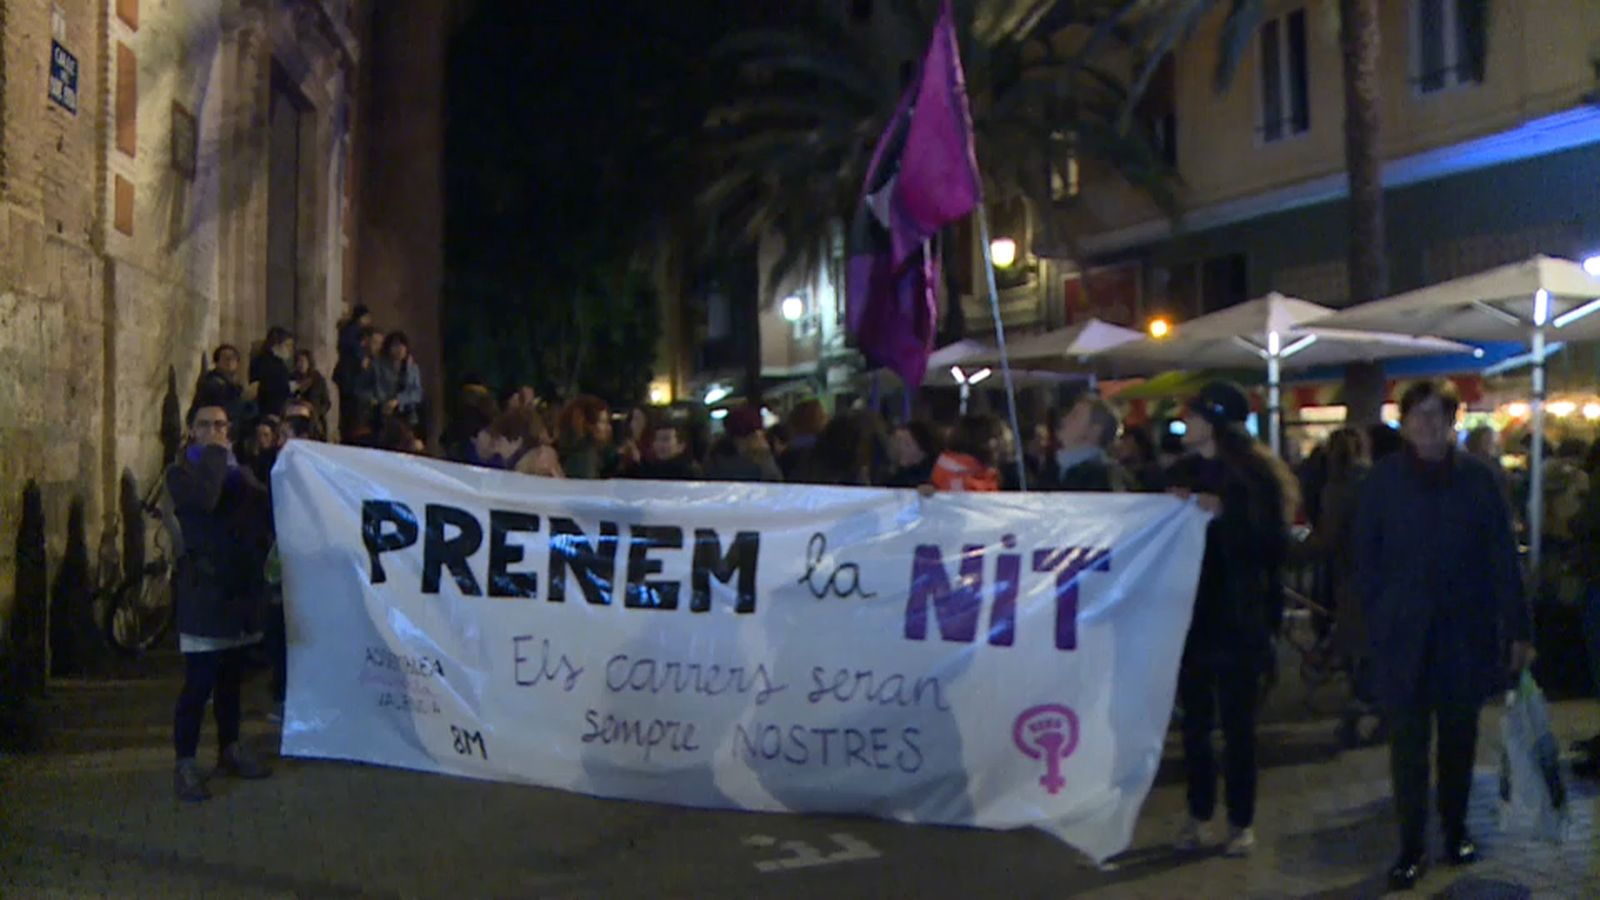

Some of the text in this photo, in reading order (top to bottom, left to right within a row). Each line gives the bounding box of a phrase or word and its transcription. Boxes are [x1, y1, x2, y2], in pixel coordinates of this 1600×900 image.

[361, 499, 760, 613] PRENEM
[798, 532, 877, 599] la
[512, 635, 951, 711] Els carrers seran
[450, 724, 488, 760] 8M
[580, 708, 925, 774] sempre NOSTRES
